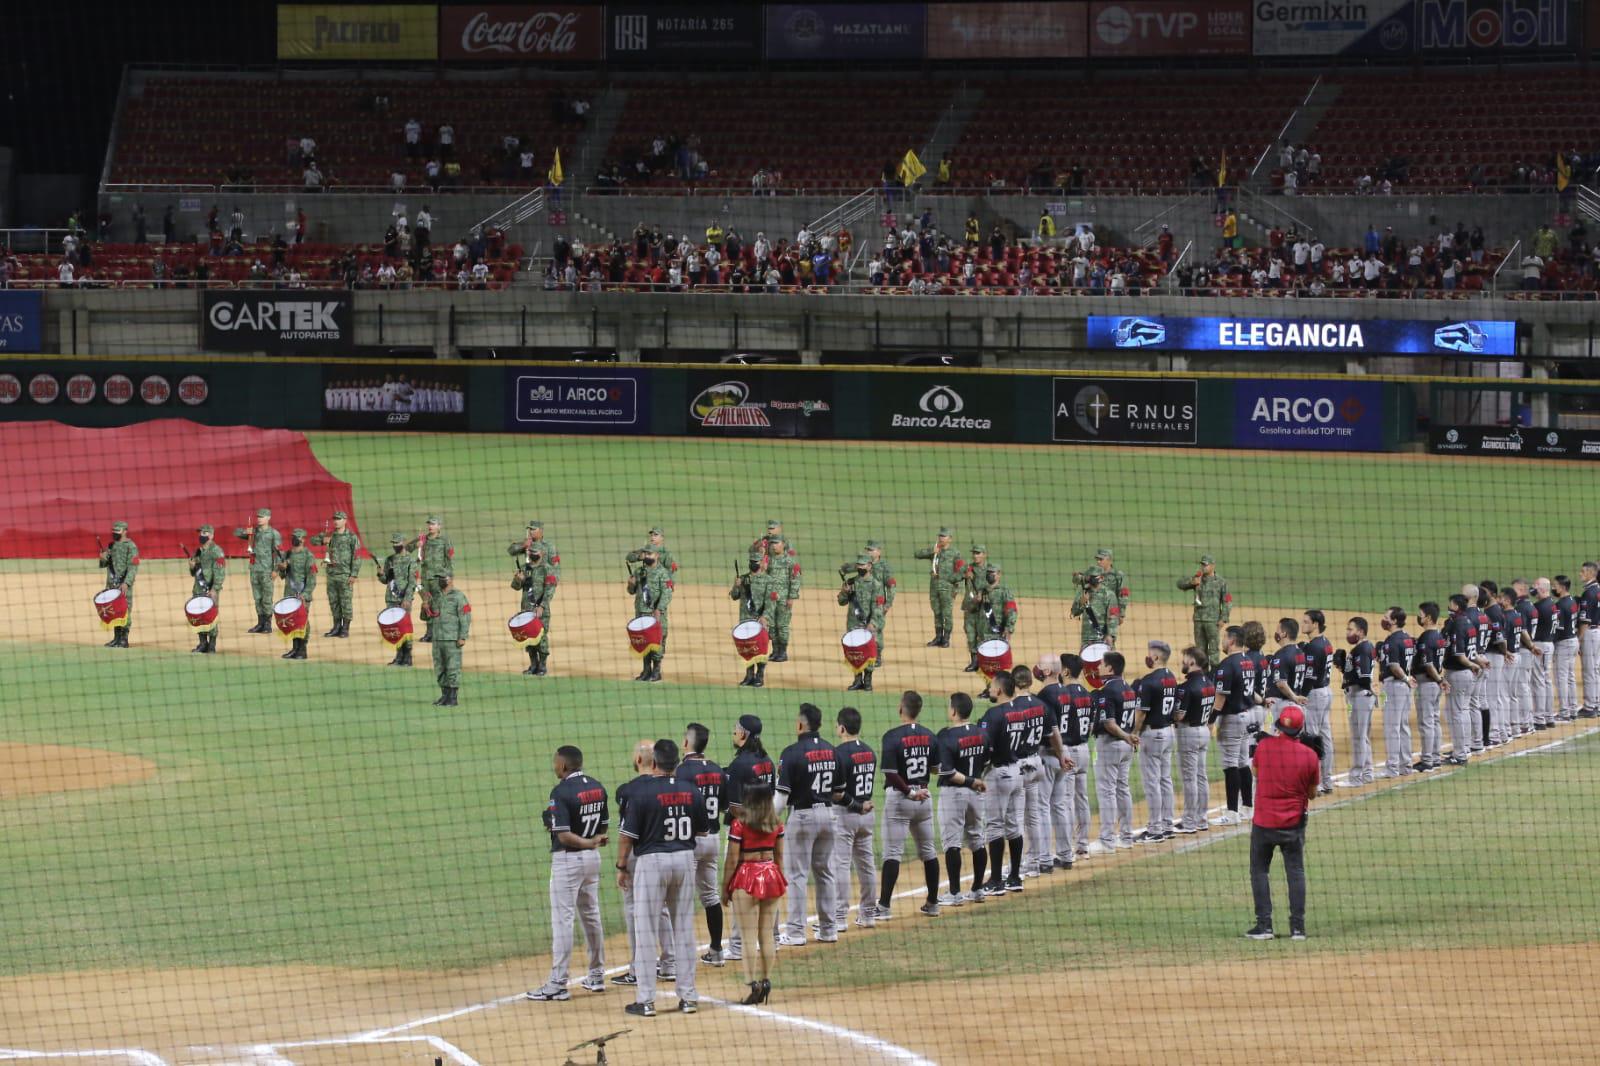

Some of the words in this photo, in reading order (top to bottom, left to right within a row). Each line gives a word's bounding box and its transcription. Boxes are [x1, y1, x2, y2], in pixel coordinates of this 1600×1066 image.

[1257, 0, 1366, 21] Germixin
[712, 18, 735, 31] 265
[1134, 12, 1198, 39] TVP
[1422, 0, 1568, 48] Mobil
[0, 315, 23, 333] AS
[209, 301, 340, 331] CARTEK
[280, 331, 341, 340] AUTOPARTES
[1219, 322, 1364, 347] ELEGANCIA
[566, 387, 608, 402] ARCO
[891, 413, 938, 428] Banco
[939, 414, 992, 429] Azteca
[1251, 397, 1335, 423] ARCO
[1130, 421, 1191, 431] FUNERALES
[1259, 426, 1291, 435] Gasolina
[1293, 427, 1319, 436] calidad
[1027, 725, 1044, 746] 43
[905, 756, 929, 780] 23
[968, 756, 975, 777] 1
[811, 771, 834, 794] 42
[855, 773, 874, 796] 26
[667, 804, 686, 817] GIL
[705, 796, 719, 820] 9
[581, 812, 601, 838] 77
[663, 816, 692, 842] 30
